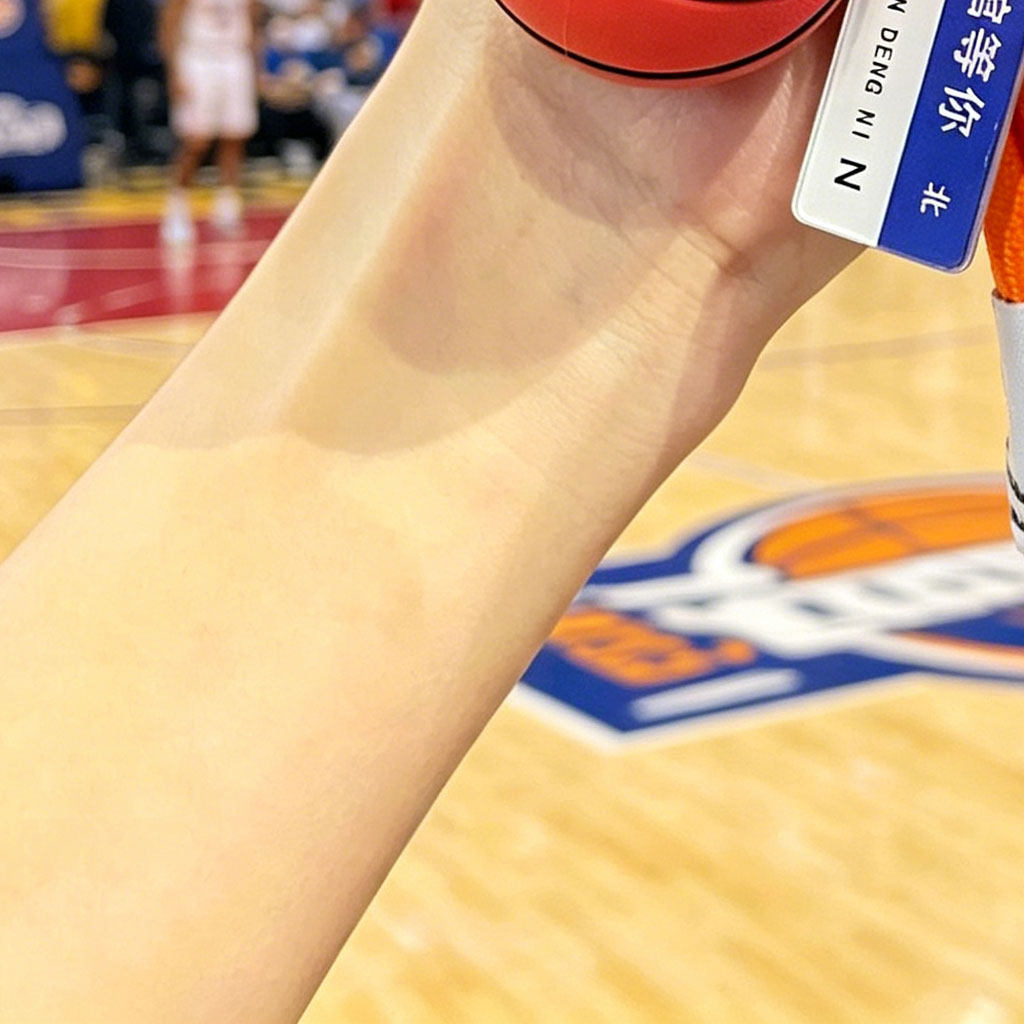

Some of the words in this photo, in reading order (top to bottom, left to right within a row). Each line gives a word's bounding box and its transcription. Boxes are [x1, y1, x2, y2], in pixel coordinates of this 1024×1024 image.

[864, 26, 899, 95] DENG
[851, 108, 876, 140] NI
[833, 157, 867, 192] N
[919, 181, 951, 217] 北
